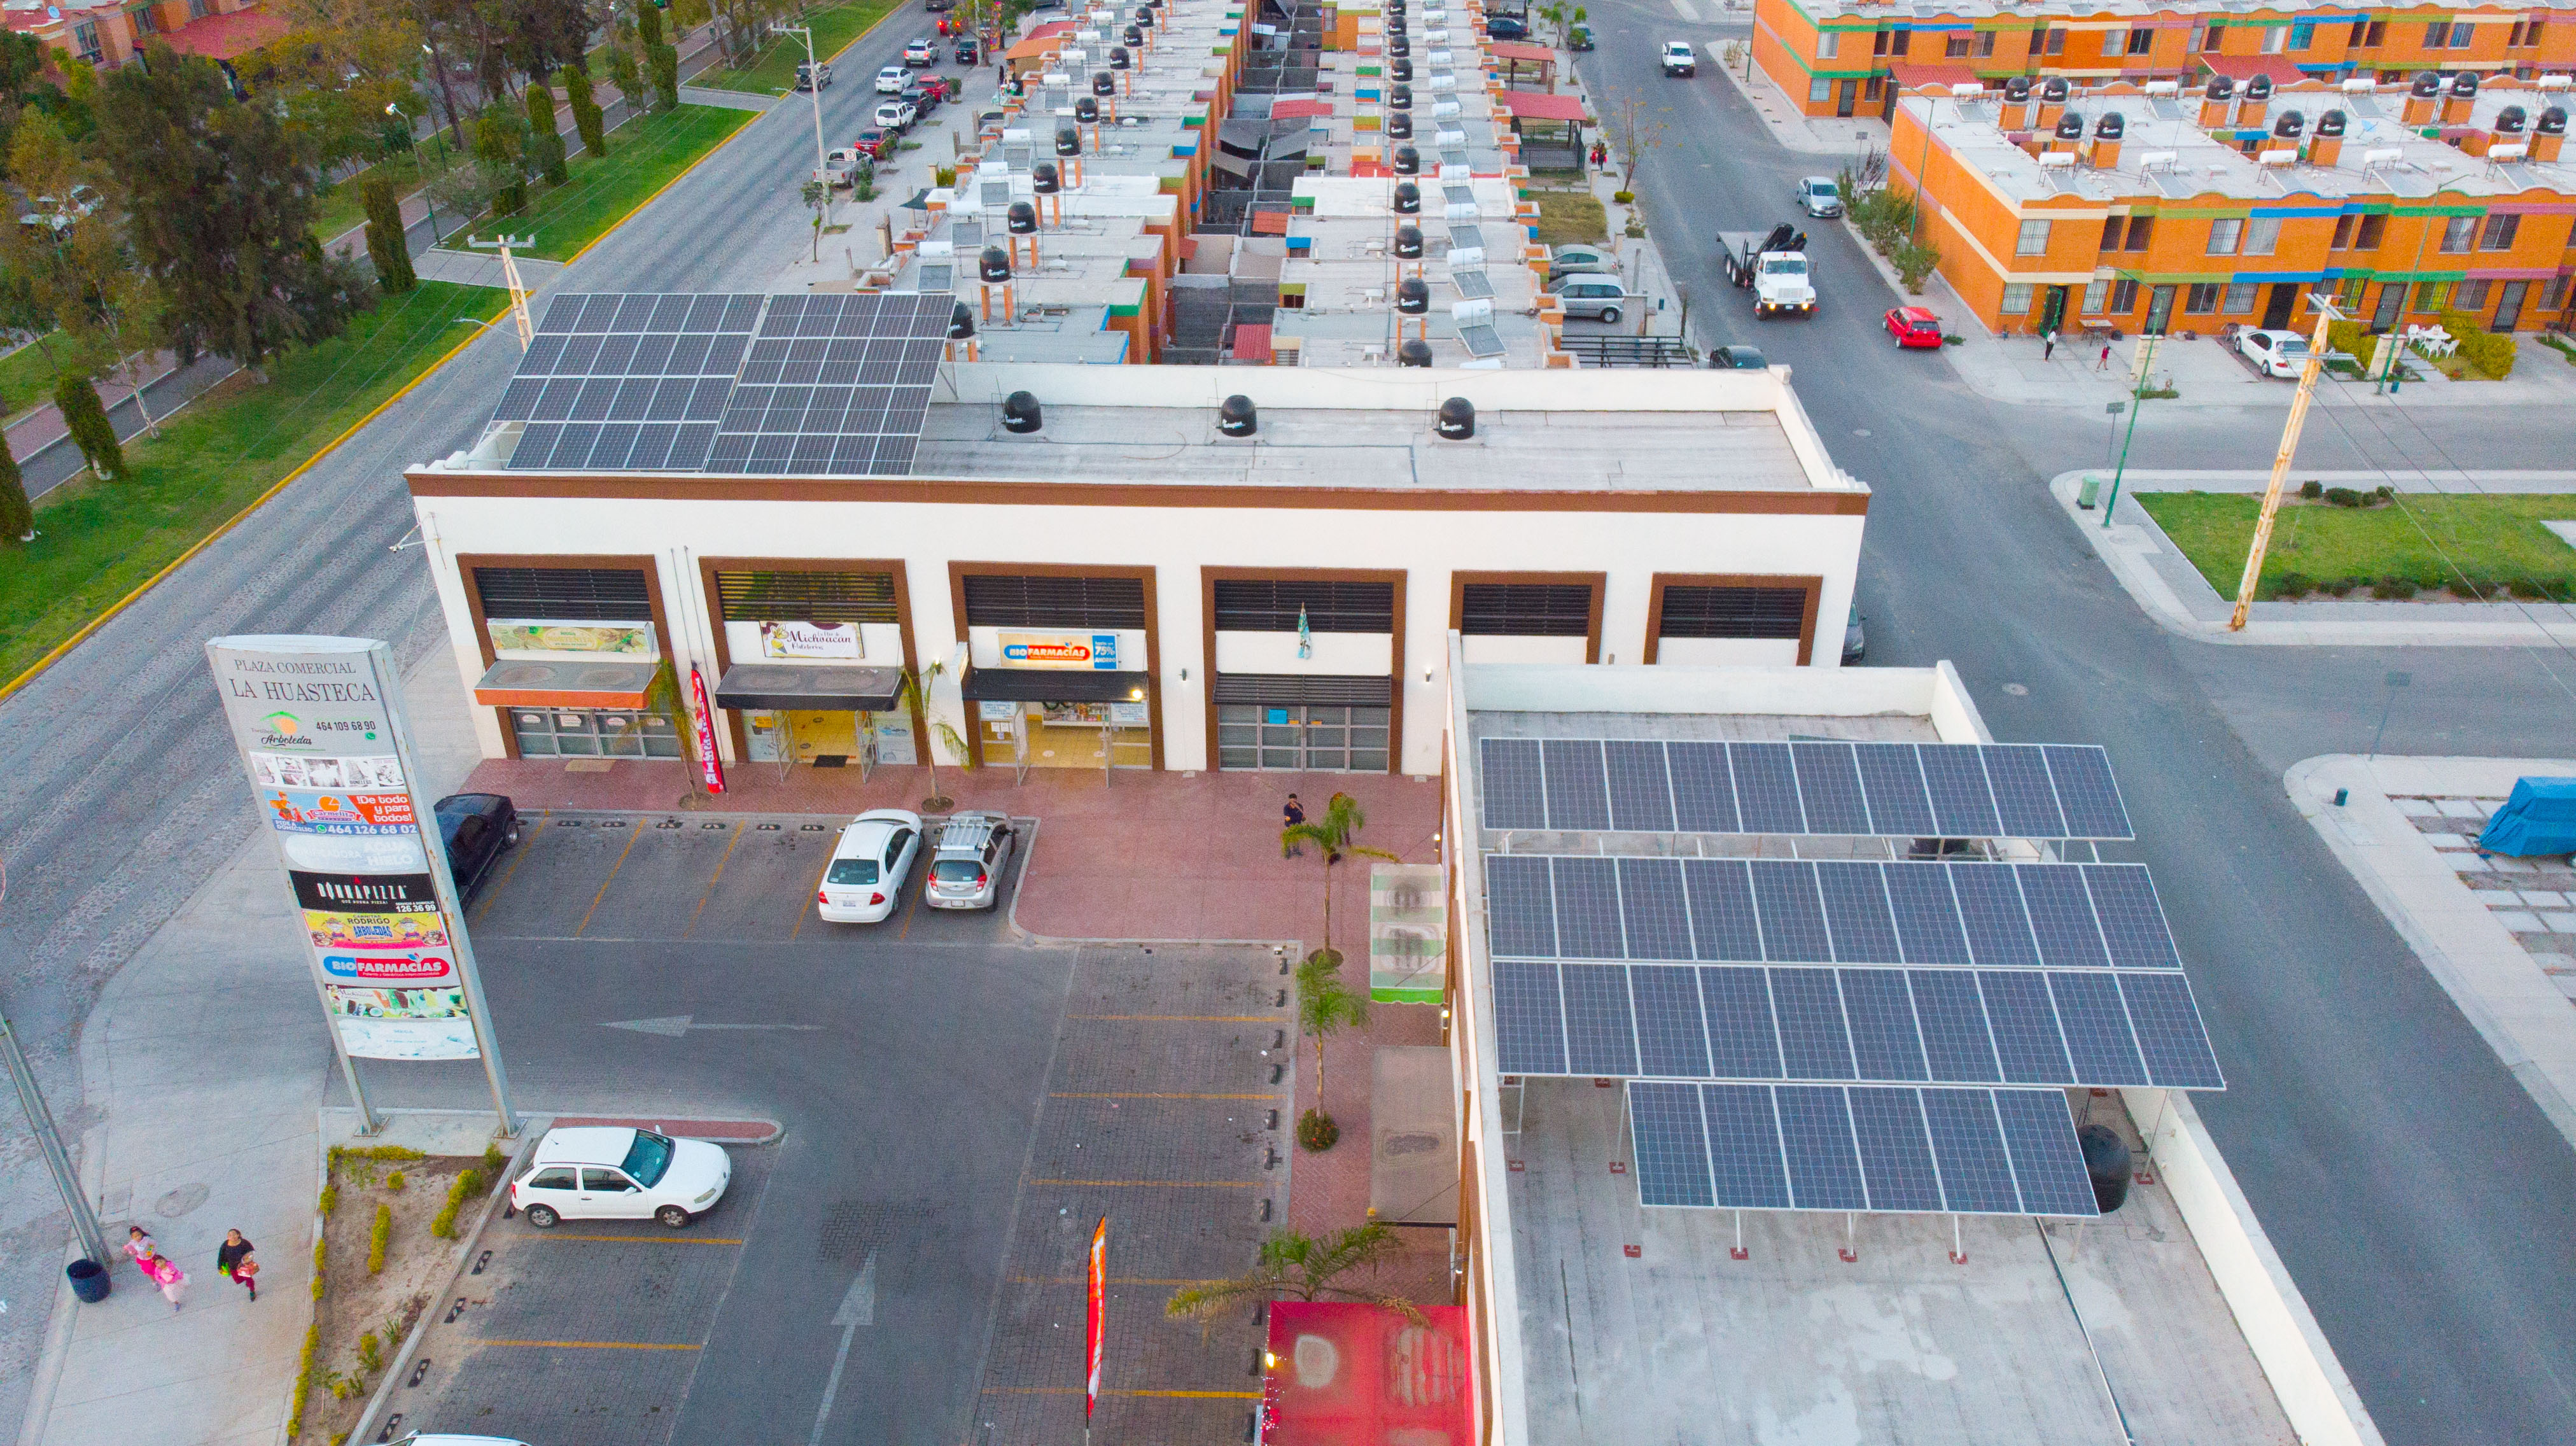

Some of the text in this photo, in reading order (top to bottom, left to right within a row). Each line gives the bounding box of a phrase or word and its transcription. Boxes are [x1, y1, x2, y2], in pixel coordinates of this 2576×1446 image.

[1095, 646, 1116, 656] 75%
[234, 659, 356, 674] PLAZA COMERCIAL
[228, 678, 377, 702] LA HUASTECA
[316, 720, 376, 731] 464 109 68 90
[261, 734, 312, 746] Arboledas
[378, 795, 408, 804] todo
[312, 810, 354, 818] Carmelita
[374, 805, 410, 815] y para
[374, 813, 413, 822] todos!
[328, 824, 417, 834] 464 126 68 02
[367, 854, 414, 866] HIELO
[396, 904, 412, 913] 126
[353, 925, 393, 938] ARBOLEDAS
